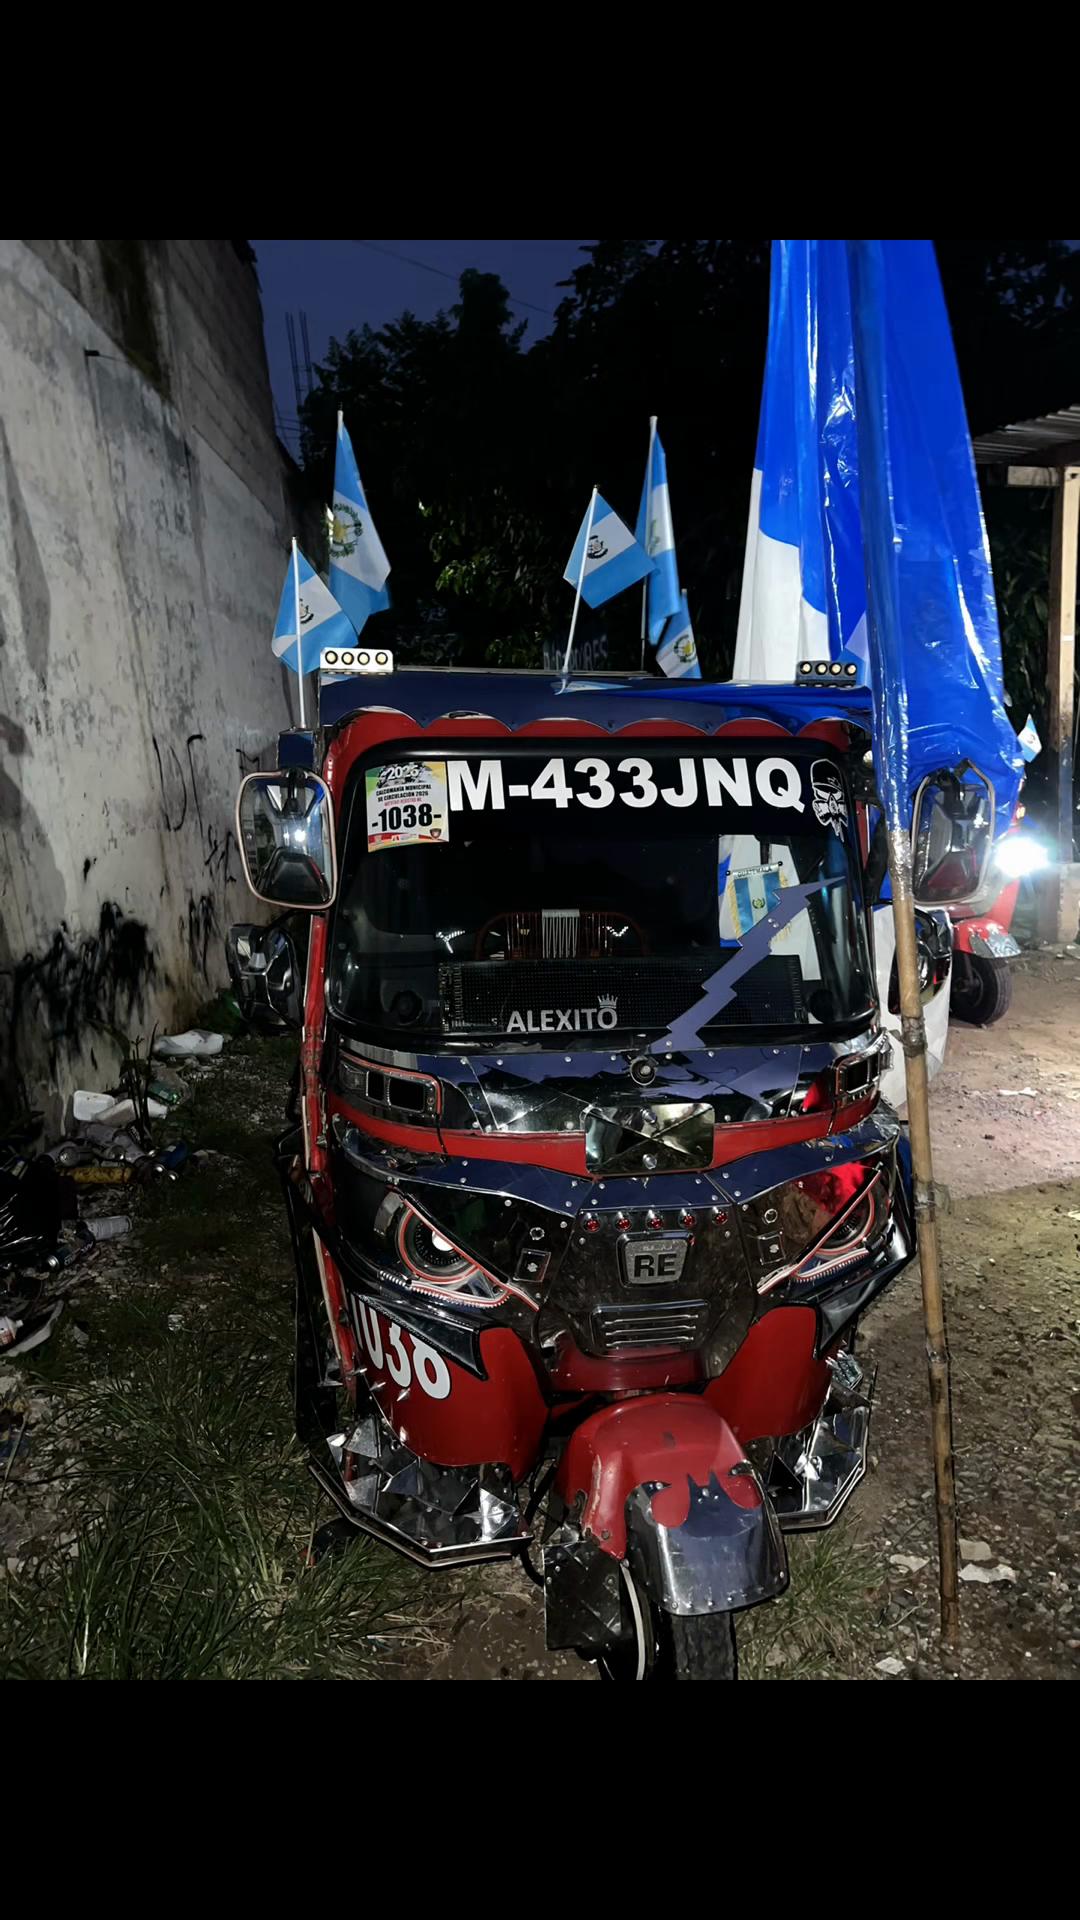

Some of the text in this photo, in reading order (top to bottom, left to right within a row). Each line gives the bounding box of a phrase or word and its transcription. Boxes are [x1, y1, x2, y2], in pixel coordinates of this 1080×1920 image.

[447, 757, 804, 813] M-433JNQ
[506, 1008, 618, 1032] ALEXITO
[634, 1251, 677, 1278] RE
